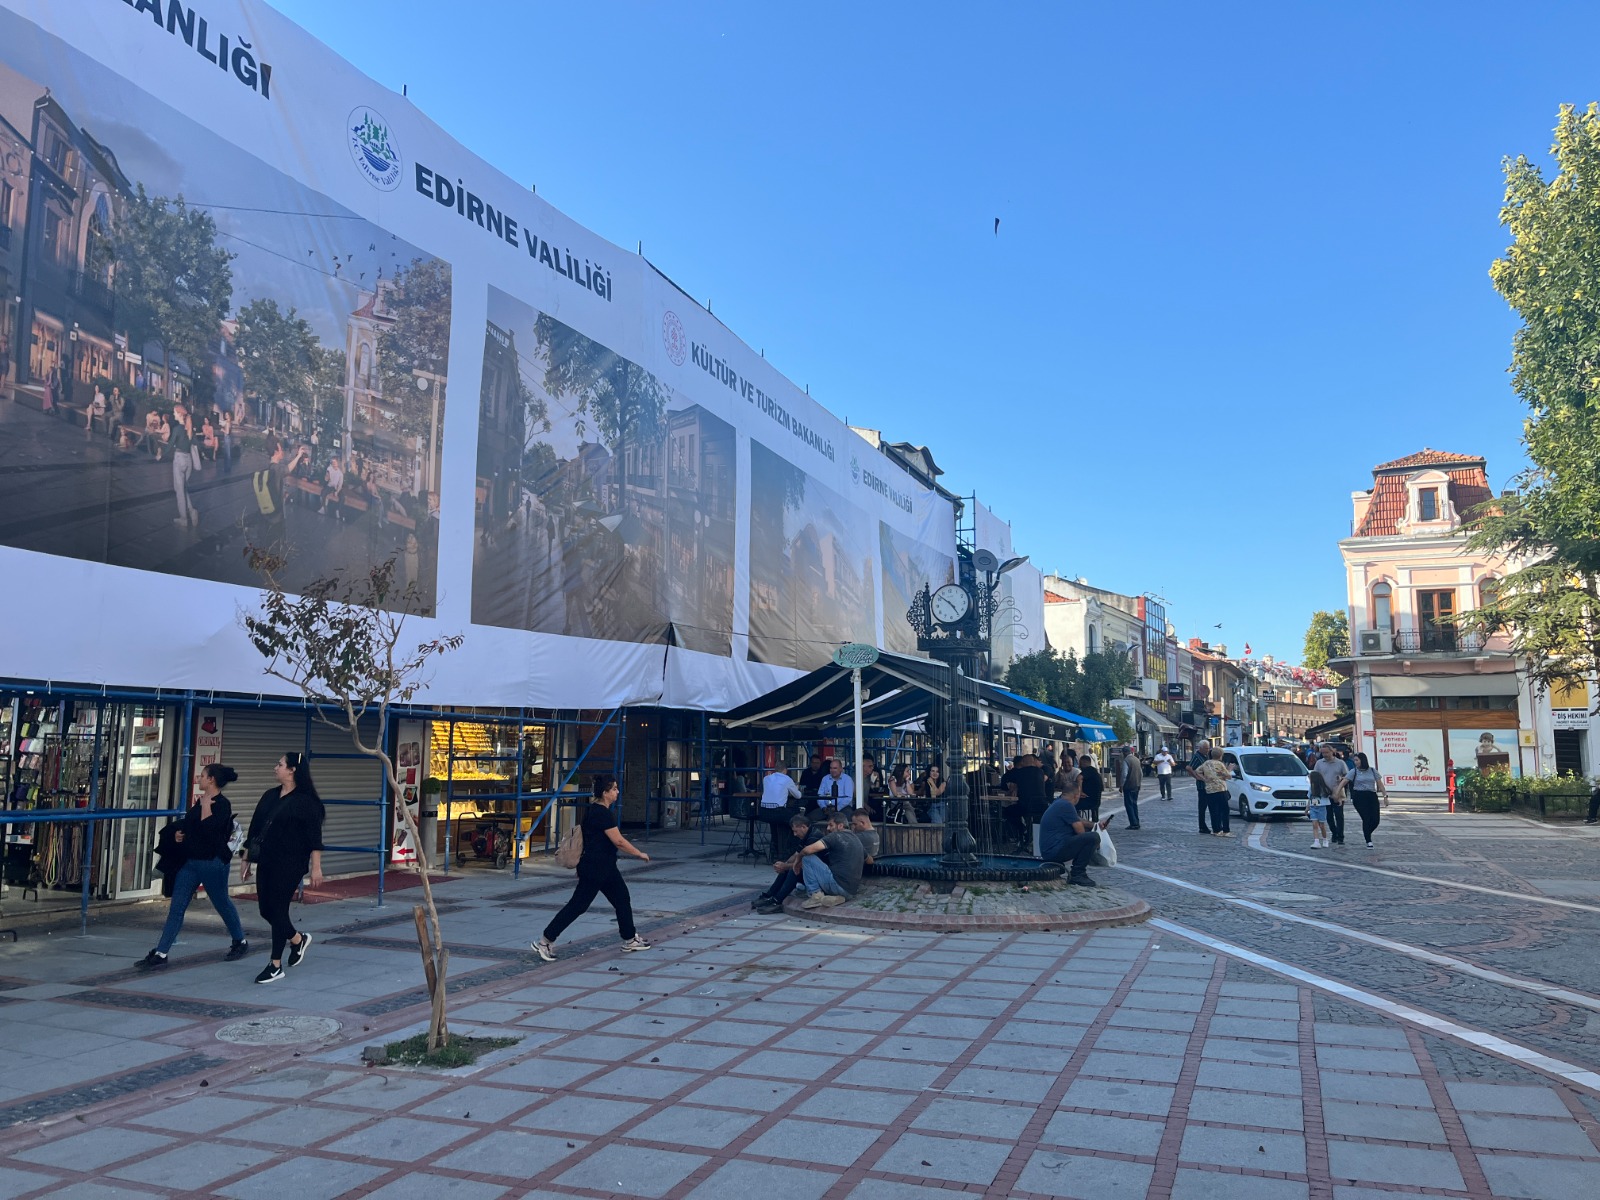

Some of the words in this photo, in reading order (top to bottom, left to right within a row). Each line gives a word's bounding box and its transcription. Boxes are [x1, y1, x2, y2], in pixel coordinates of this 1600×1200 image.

[122, 0, 272, 100] ANLIĞI
[415, 162, 519, 248] EDİRNE
[523, 227, 612, 302] VALİLİĞİ
[691, 341, 737, 392] KÜLTÜR
[740, 376, 754, 403] VE
[756, 388, 790, 430] TURİZM
[791, 416, 835, 463] BAKANLIĞI
[863, 469, 888, 499] EDİRNE
[889, 486, 912, 514] VALİLİĞİ
[1321, 696, 1333, 706] E
[1557, 712, 1567, 720] DİŞ
